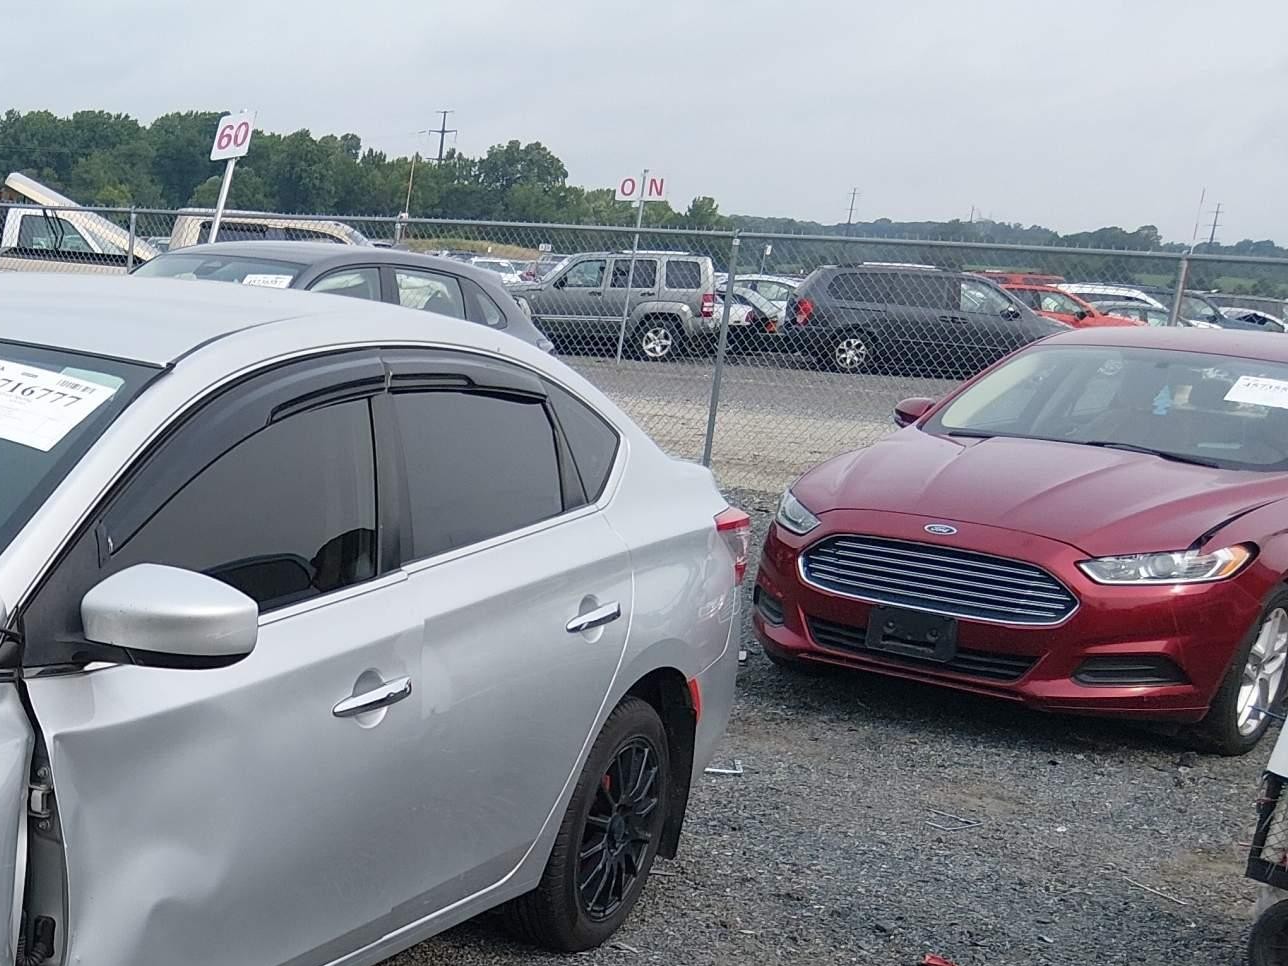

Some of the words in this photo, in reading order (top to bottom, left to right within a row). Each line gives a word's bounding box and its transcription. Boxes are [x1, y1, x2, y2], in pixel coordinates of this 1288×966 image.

[217, 121, 250, 150] 60
[620, 178, 640, 197] O
[648, 178, 665, 197] N
